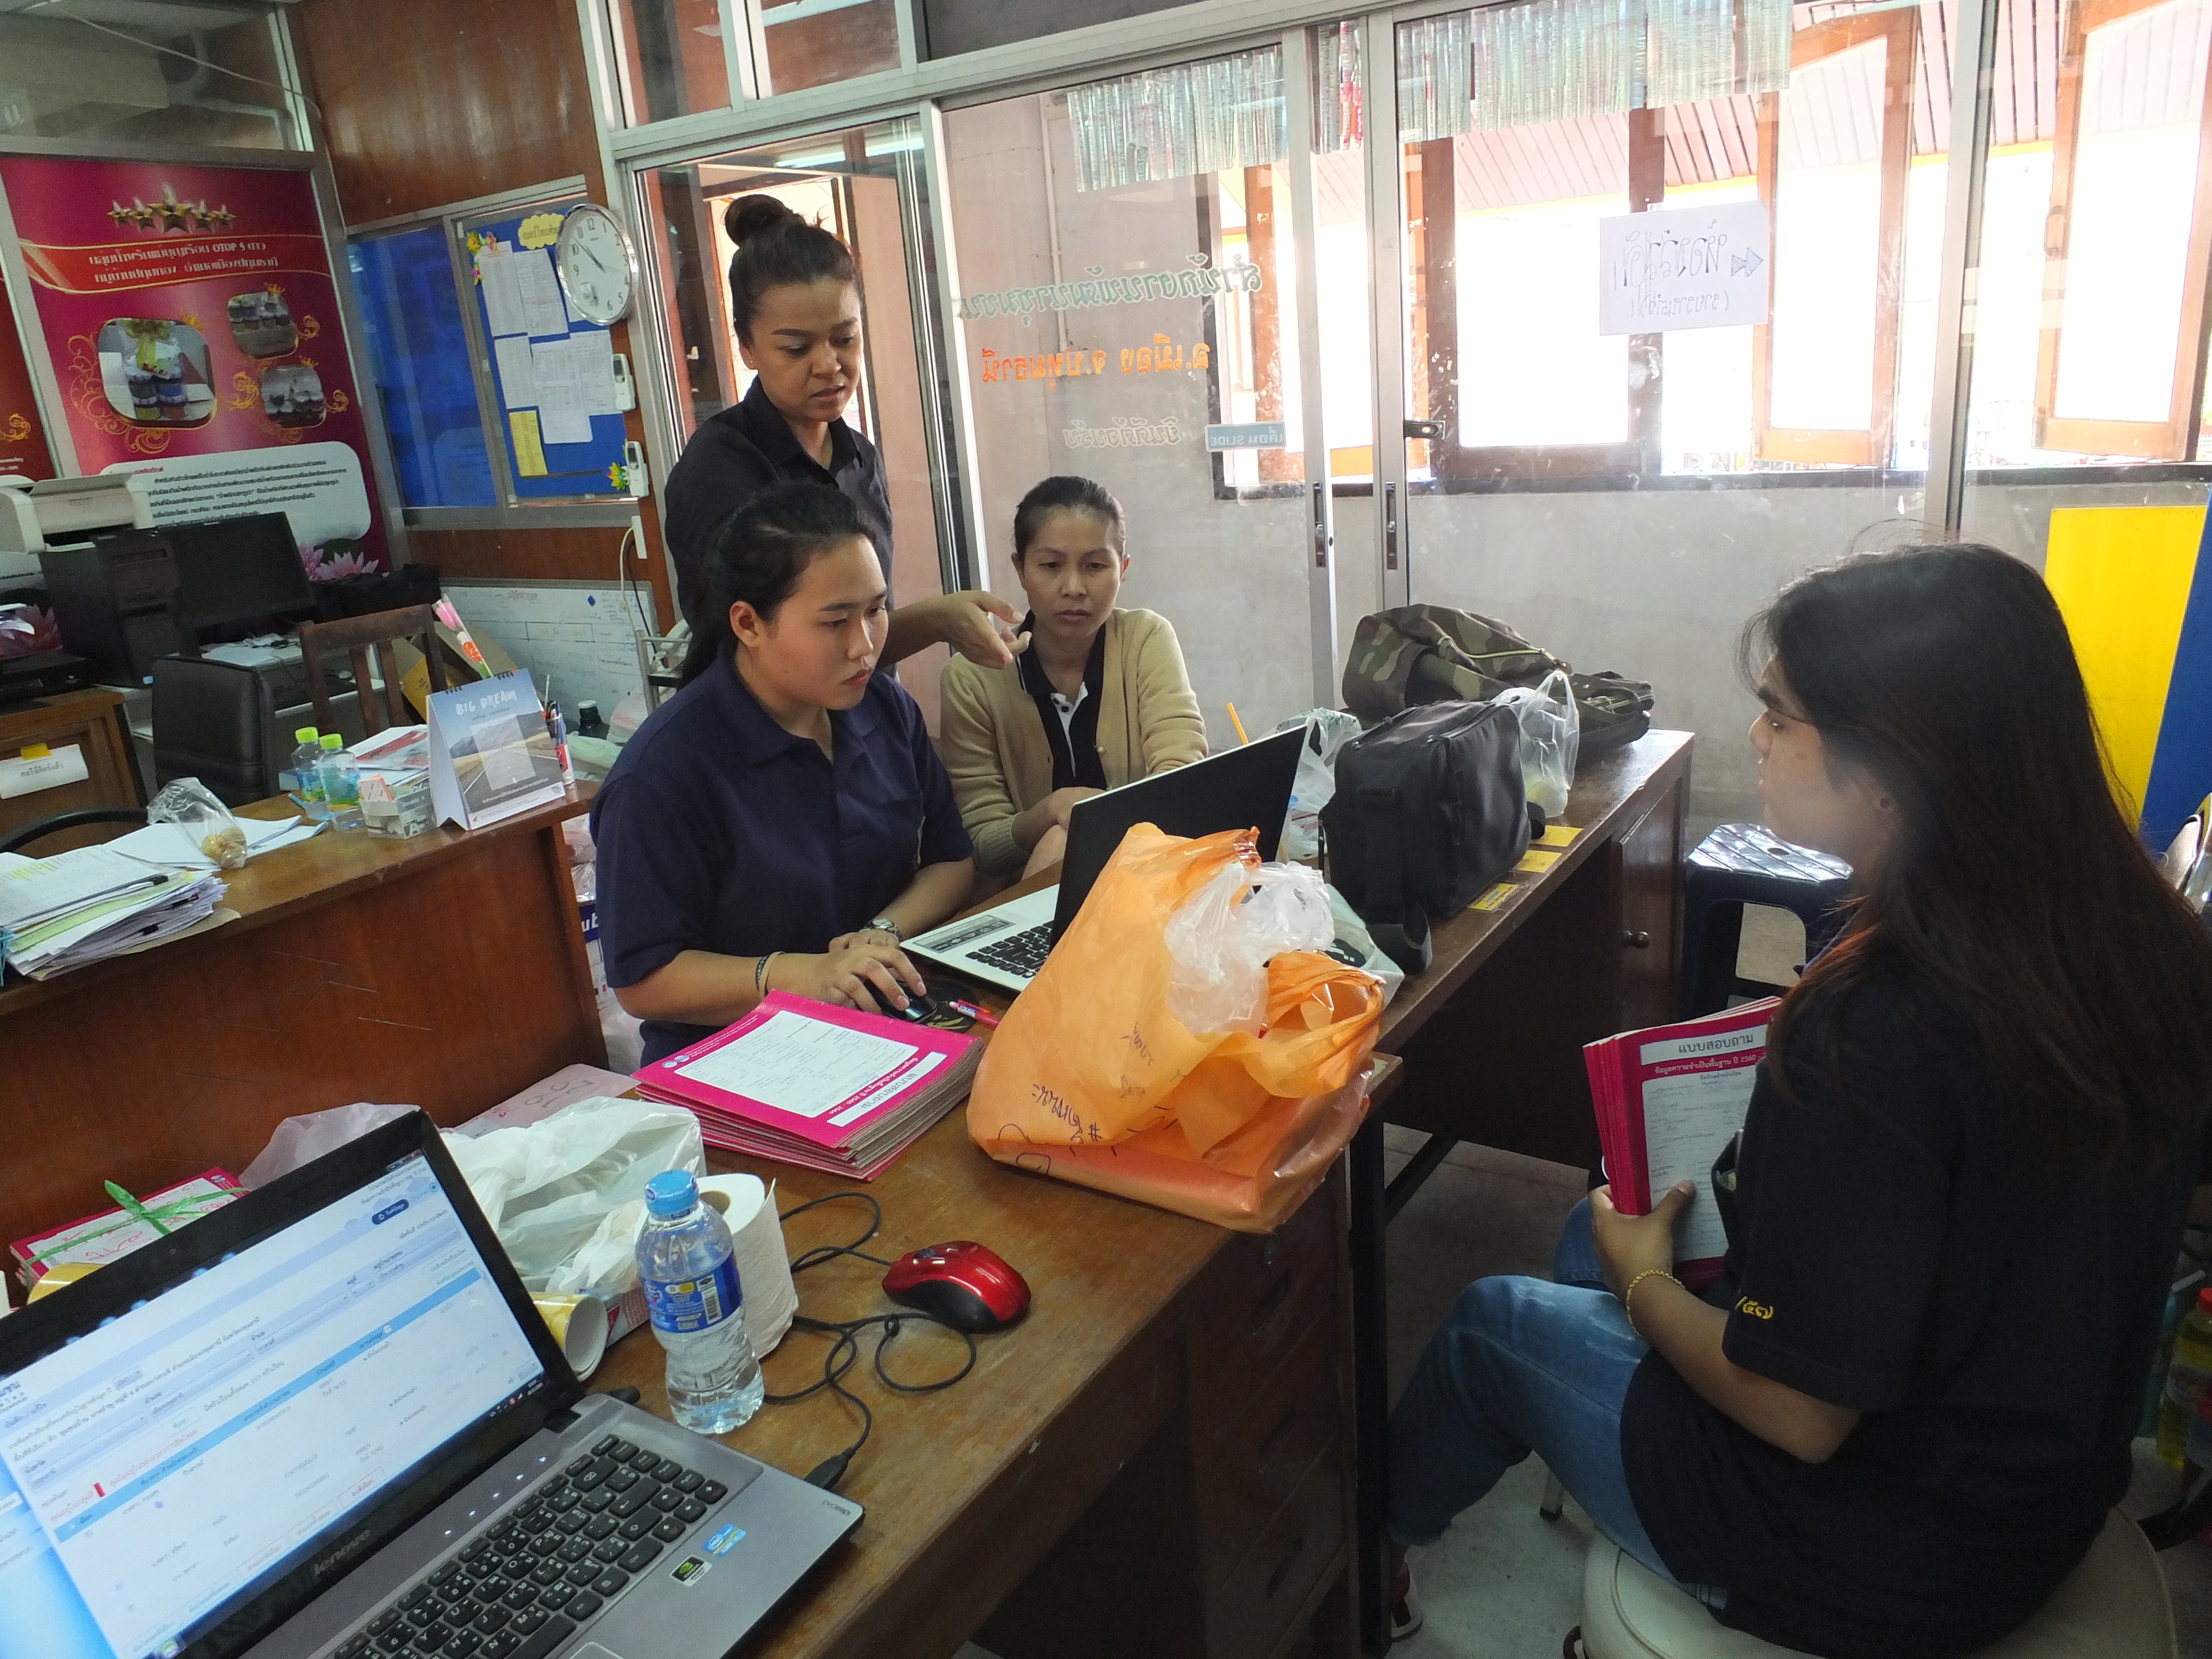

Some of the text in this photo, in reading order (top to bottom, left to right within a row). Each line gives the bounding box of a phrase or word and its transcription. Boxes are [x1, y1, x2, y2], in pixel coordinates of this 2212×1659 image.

[587, 217, 596, 231] 12
[614, 233, 620, 246] 2
[212, 243, 237, 252] OTOP
[573, 264, 579, 276] 9
[618, 292, 623, 304] 5
[607, 299, 613, 311] 6
[455, 701, 476, 716] BIG
[481, 689, 518, 710] DREAM
[1678, 1034, 1753, 1053] แบบสอบถาม
[860, 1073, 917, 1109] แบบสอบถาม
